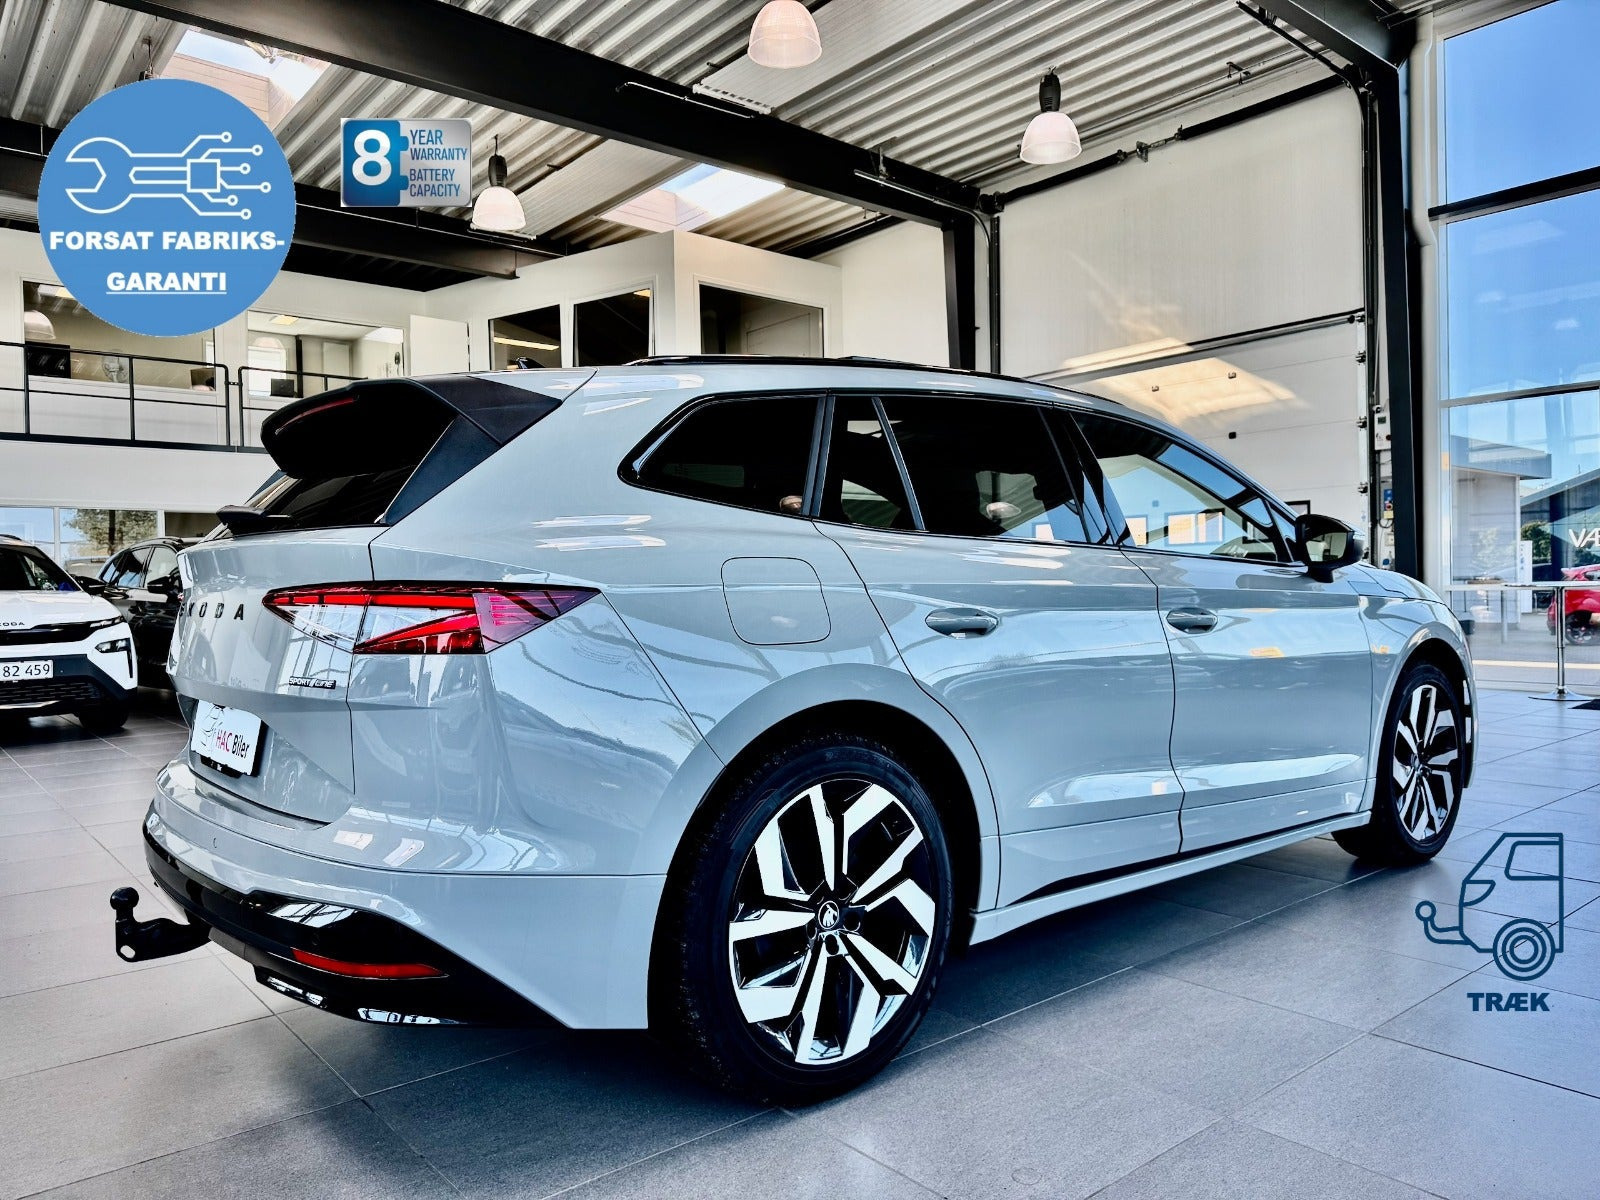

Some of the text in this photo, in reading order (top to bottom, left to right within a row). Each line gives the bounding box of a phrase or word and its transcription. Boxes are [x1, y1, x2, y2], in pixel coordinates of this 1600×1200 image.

[3, 663, 50, 677] 82 459
[232, 735, 250, 758] Biler
